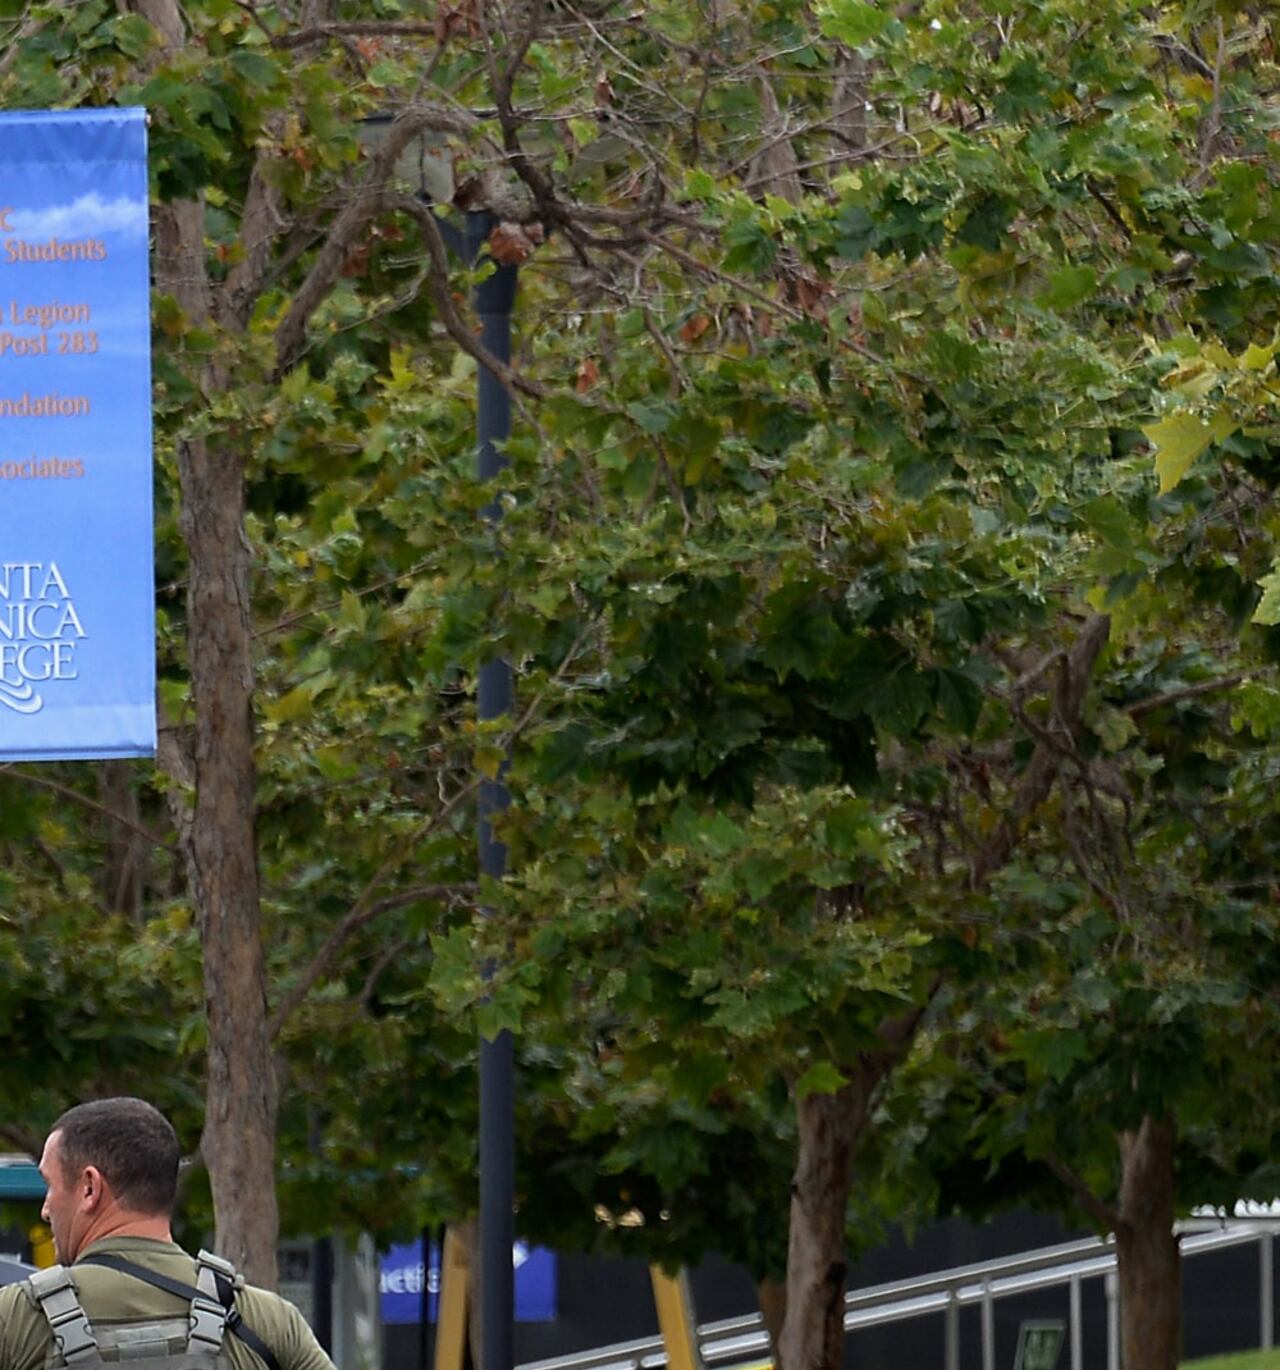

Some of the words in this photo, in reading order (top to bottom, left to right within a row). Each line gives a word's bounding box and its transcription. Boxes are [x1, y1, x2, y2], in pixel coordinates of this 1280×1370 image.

[3, 237, 108, 264] Students
[9, 300, 91, 330] Legion
[57, 329, 99, 355] 283
